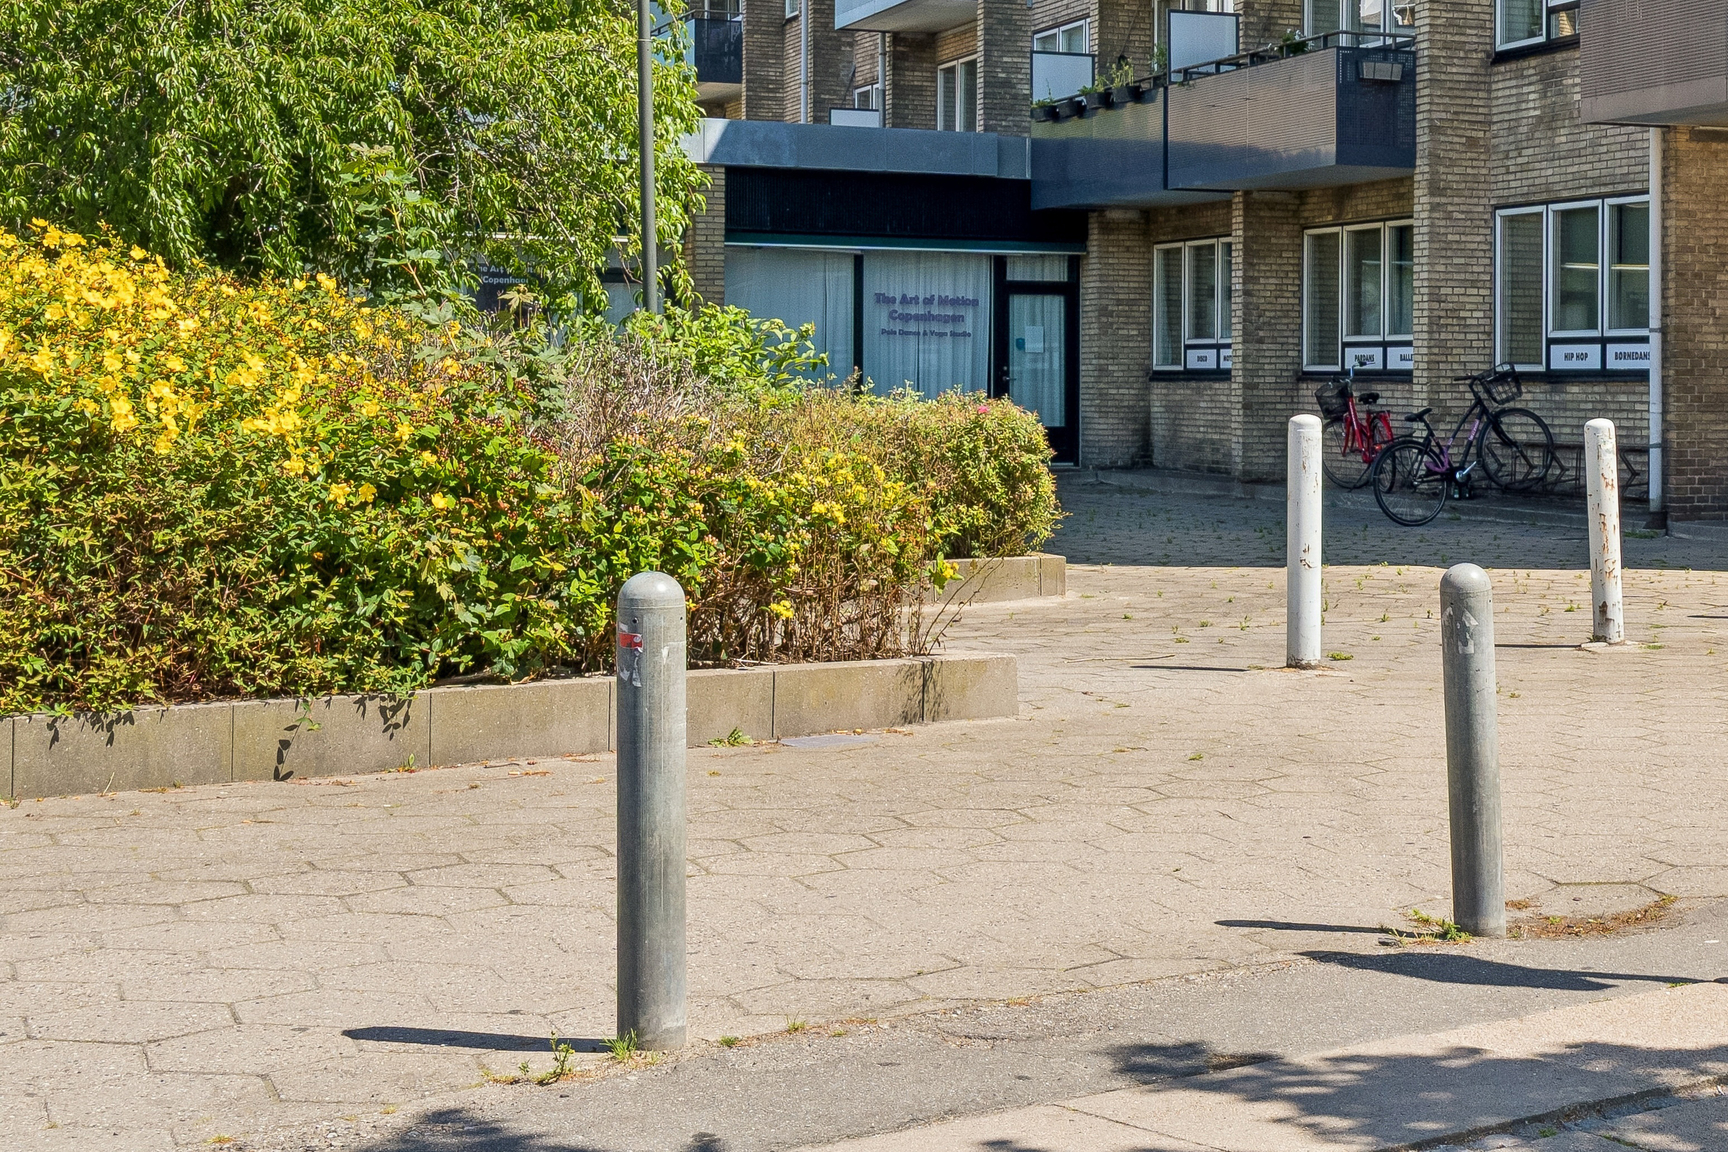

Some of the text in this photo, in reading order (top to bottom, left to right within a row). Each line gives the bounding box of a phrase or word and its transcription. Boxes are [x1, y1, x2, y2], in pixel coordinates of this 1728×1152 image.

[875, 292, 979, 306] The Art of Motion
[889, 309, 964, 323] Copenhagen
[1355, 354, 1374, 362] PARDANS
[1564, 352, 1588, 361] HIP HOP
